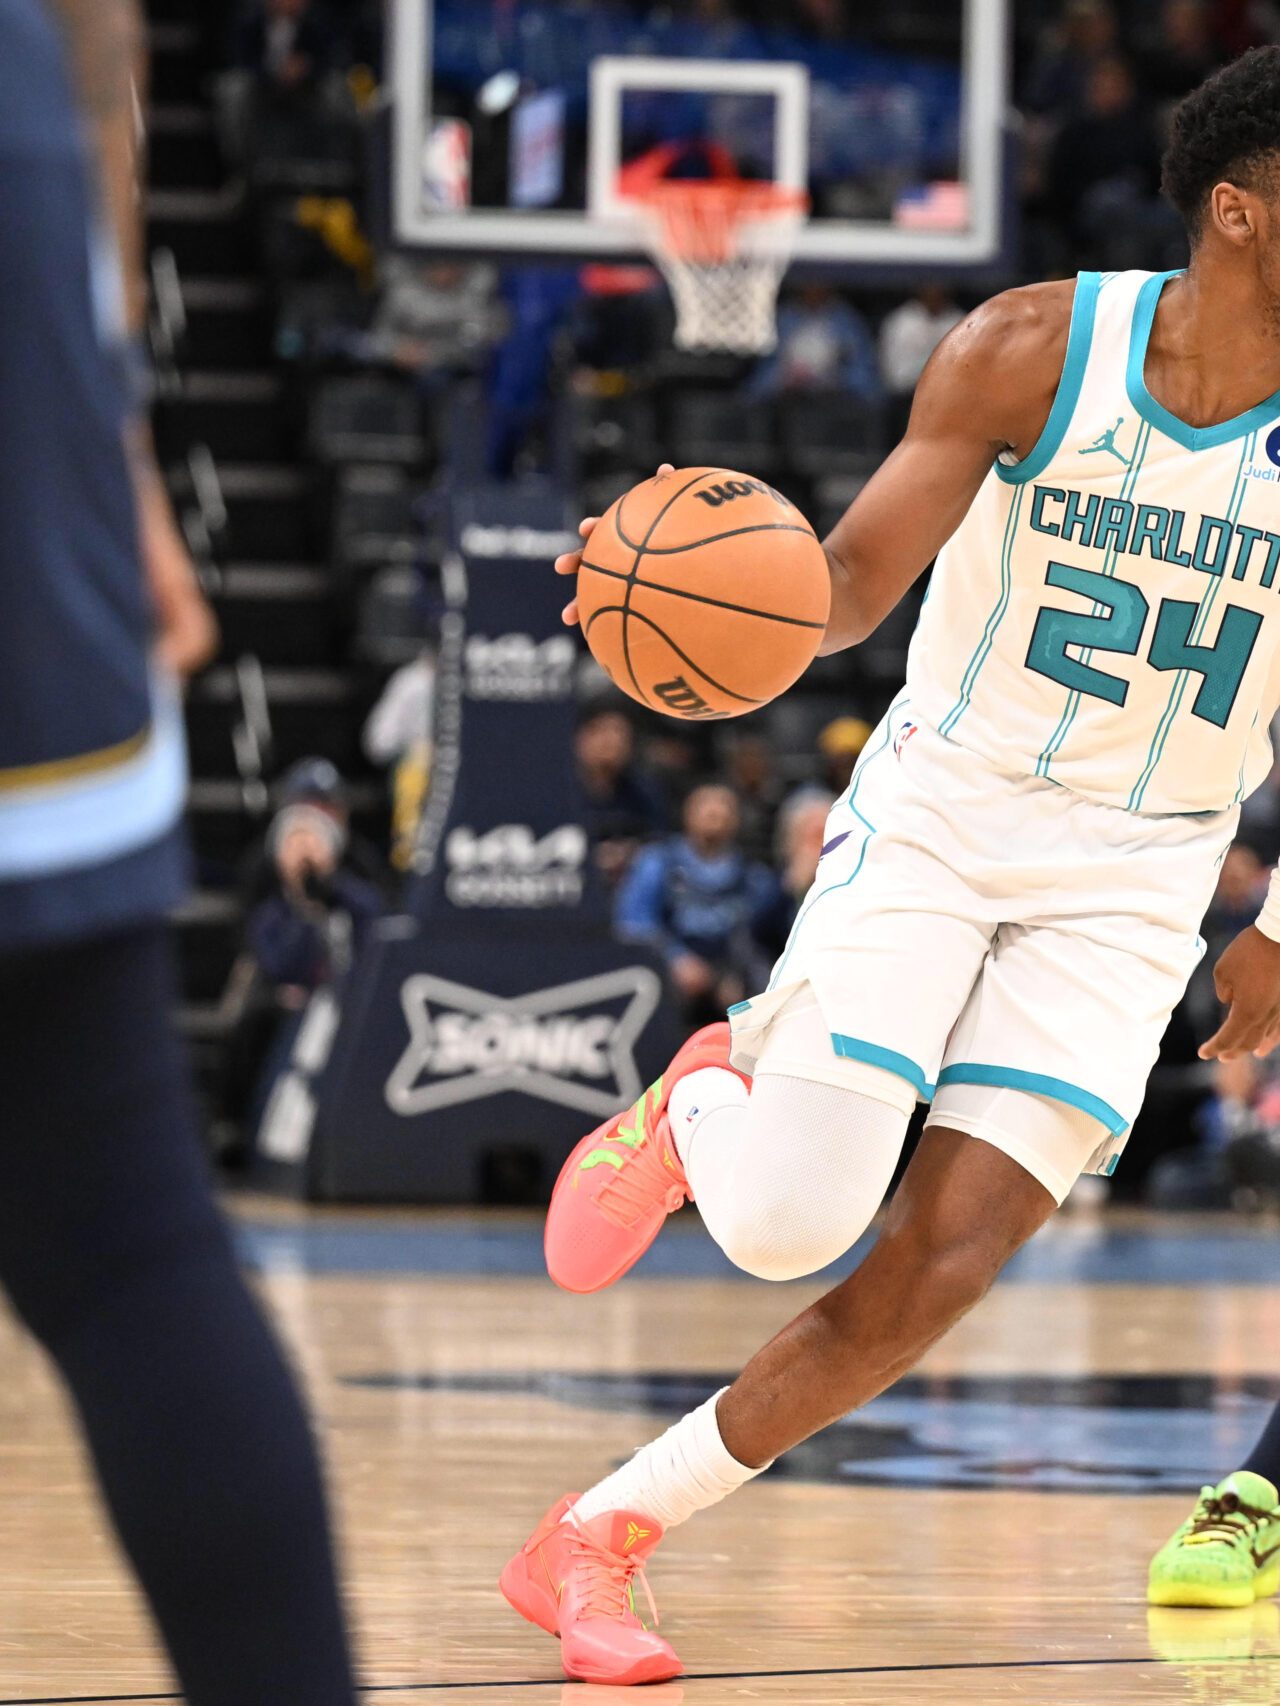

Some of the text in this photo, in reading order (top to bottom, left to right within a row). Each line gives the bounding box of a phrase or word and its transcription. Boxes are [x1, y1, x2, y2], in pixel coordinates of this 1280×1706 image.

[1243, 463, 1276, 482] Judi
[1023, 560, 1265, 730] 24
[428, 1012, 618, 1081] SONIC
